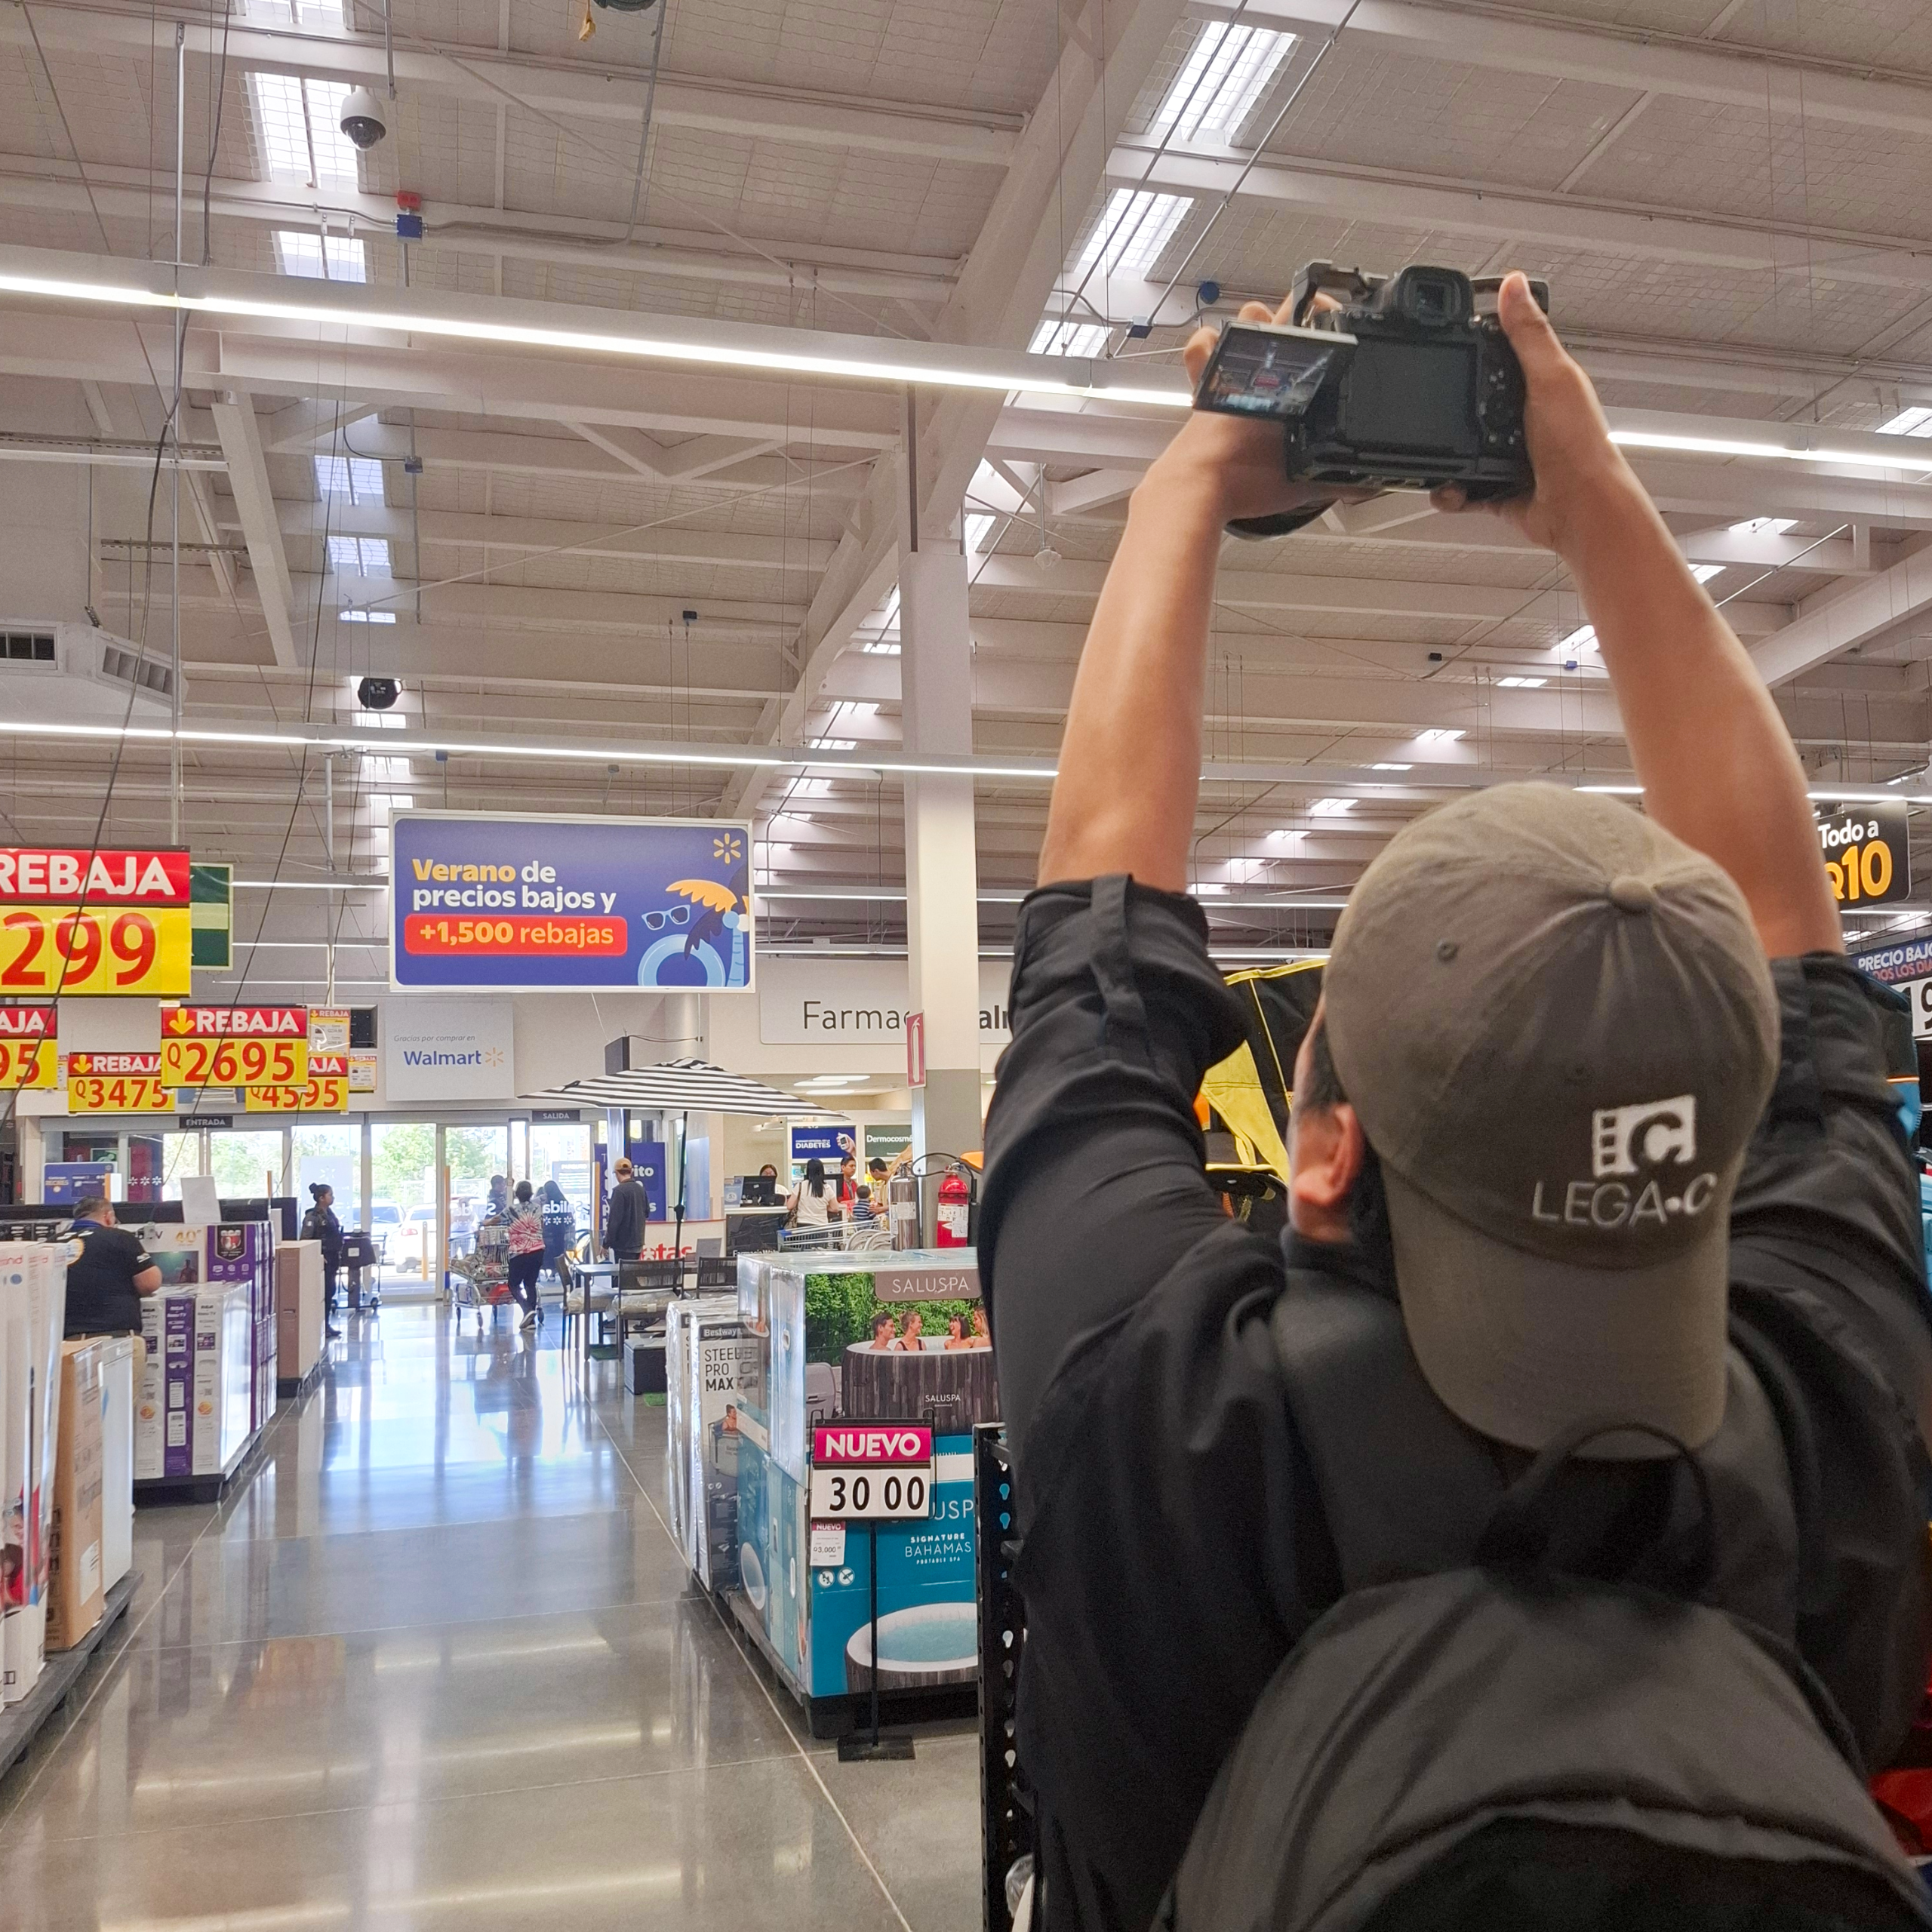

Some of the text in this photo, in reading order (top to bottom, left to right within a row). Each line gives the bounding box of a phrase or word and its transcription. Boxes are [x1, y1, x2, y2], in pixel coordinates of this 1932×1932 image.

[1818, 819, 1878, 848] Todo a
[412, 859, 556, 883] Verano de
[1824, 840, 1892, 900] Q10
[413, 885, 616, 913] precios bajos y
[420, 921, 614, 948] +1,500 rebajas
[1858, 949, 1903, 971] PRECIO
[1896, 963, 1915, 977] LOS
[196, 1011, 300, 1032] REBAJA
[168, 1041, 294, 1082] Q2695
[404, 1051, 481, 1066] Walmart
[892, 1276, 970, 1294] SALUSPA
[703, 1327, 737, 1337] Bestway
[704, 1347, 740, 1362] STEEL
[705, 1363, 730, 1377] PRO
[706, 1377, 734, 1392] MAX
[925, 1394, 961, 1402] SALUSPA
[826, 1432, 921, 1457] NUEVO
[910, 1533, 965, 1543] SIGNATURE
[905, 1541, 971, 1558] BAHAMAS
